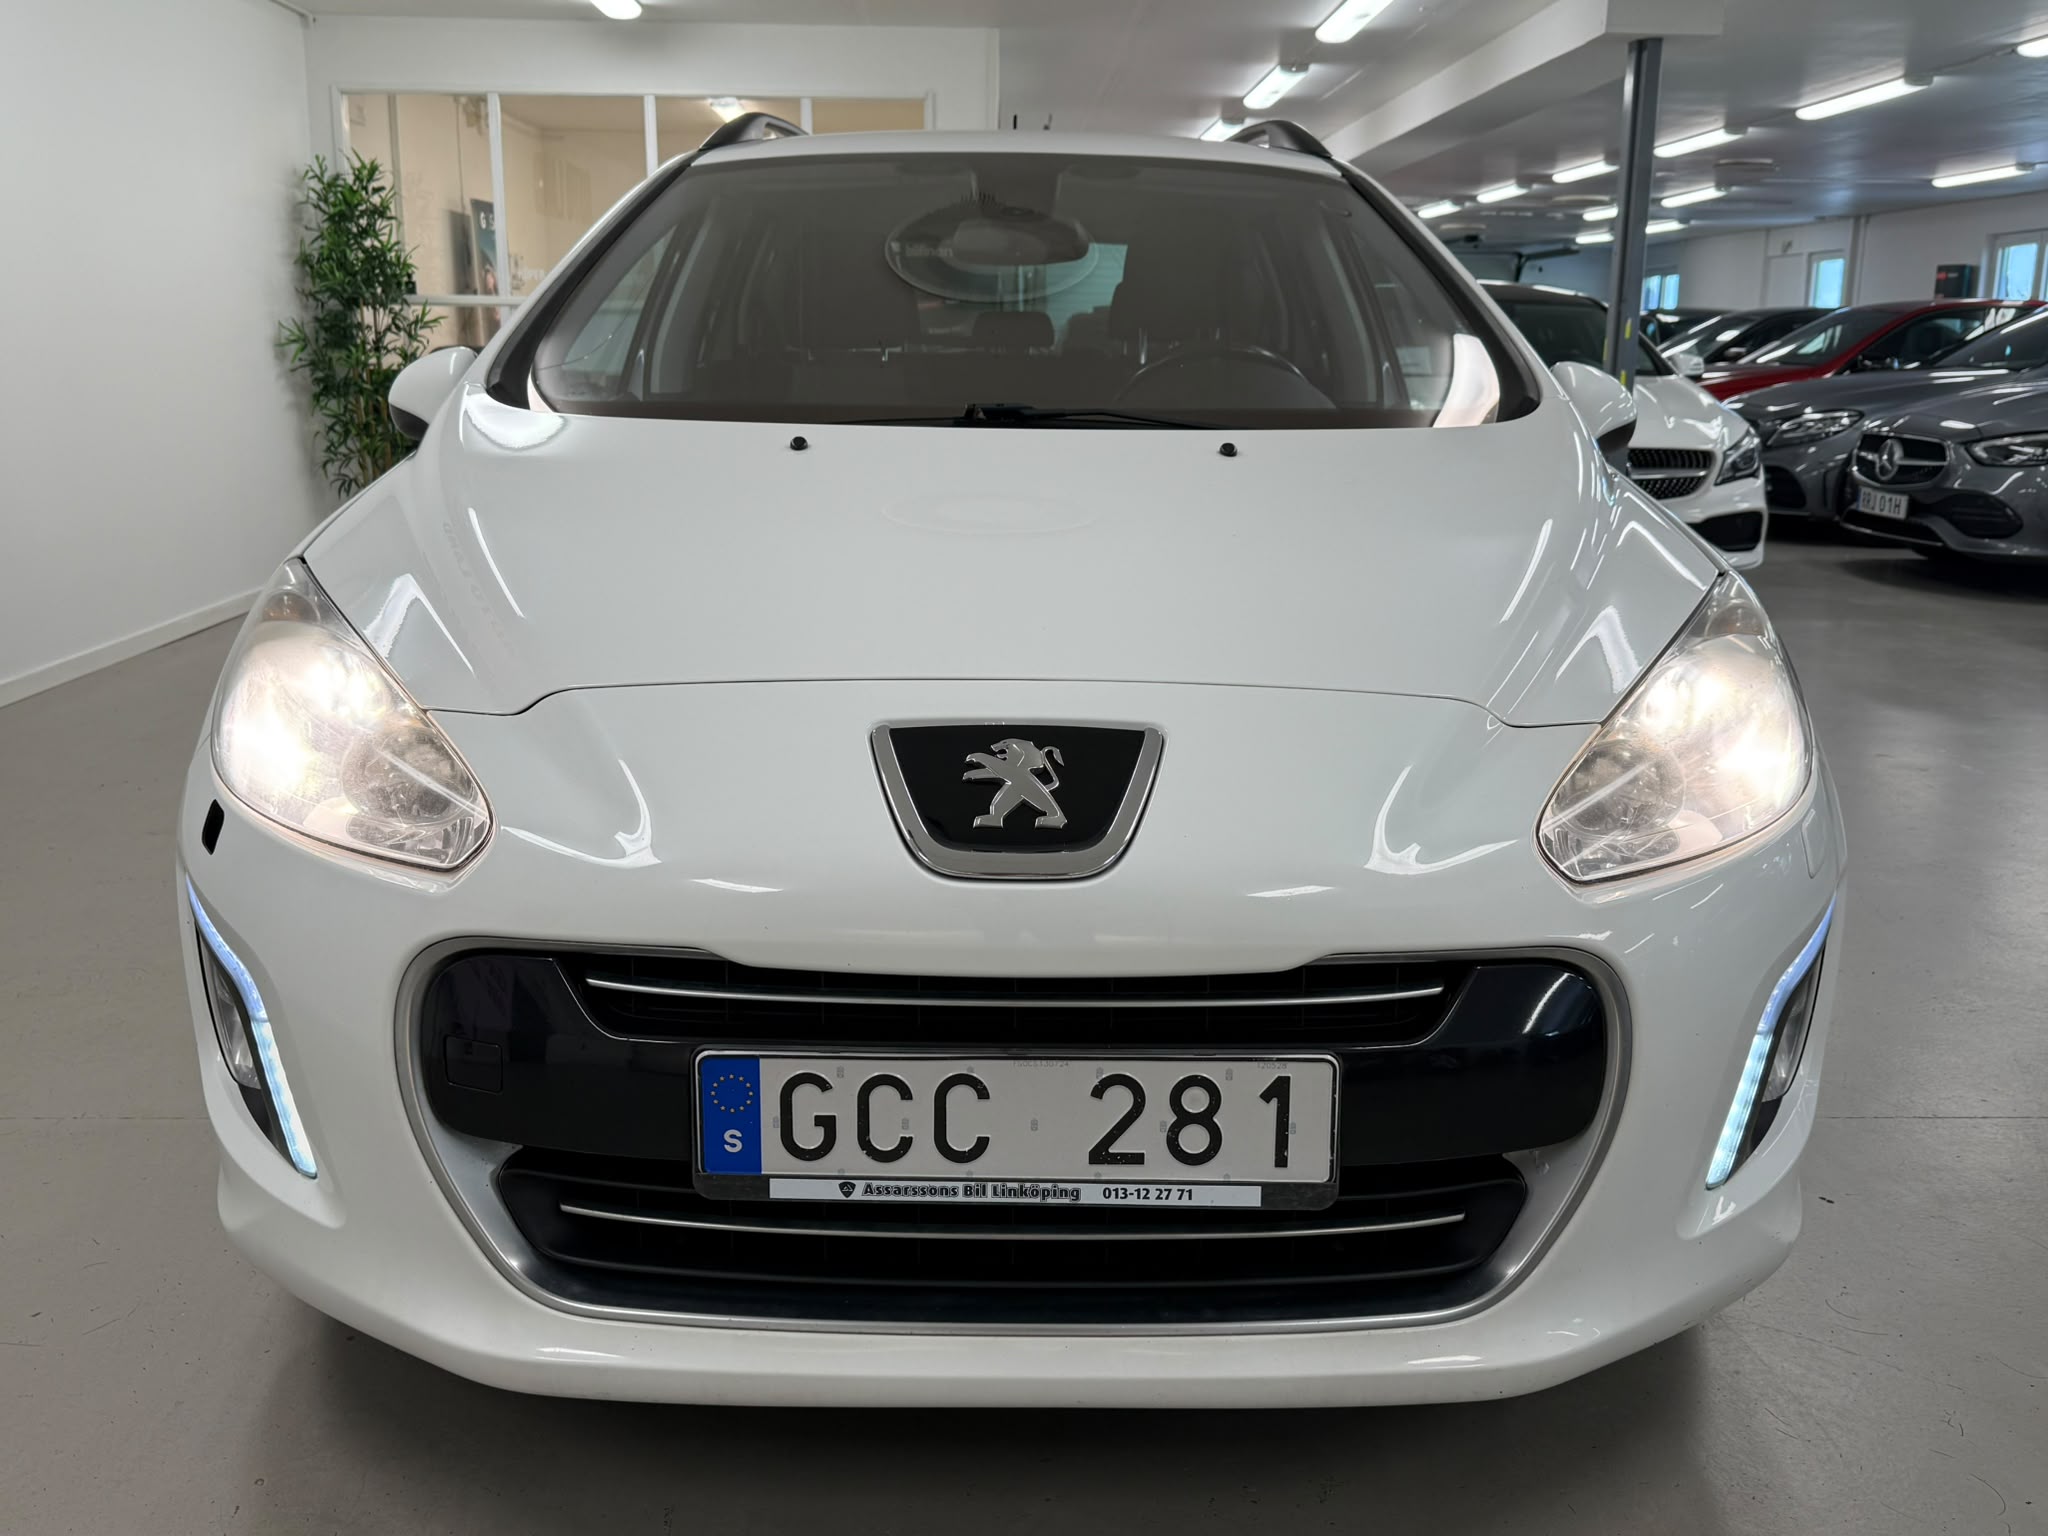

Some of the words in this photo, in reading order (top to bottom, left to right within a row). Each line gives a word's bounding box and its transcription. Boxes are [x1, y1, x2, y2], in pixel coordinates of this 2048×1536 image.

[779, 1072, 990, 1164] GCC
[1088, 1073, 1292, 1168] 281
[723, 1129, 743, 1153] S
[861, 1181, 958, 1198] Assarssons
[962, 1183, 987, 1199] Bil
[992, 1183, 1081, 1202] Linköping
[1102, 1186, 1150, 1200] 013-12
[1155, 1188, 1173, 1200] 27
[1176, 1188, 1193, 1201] 71
